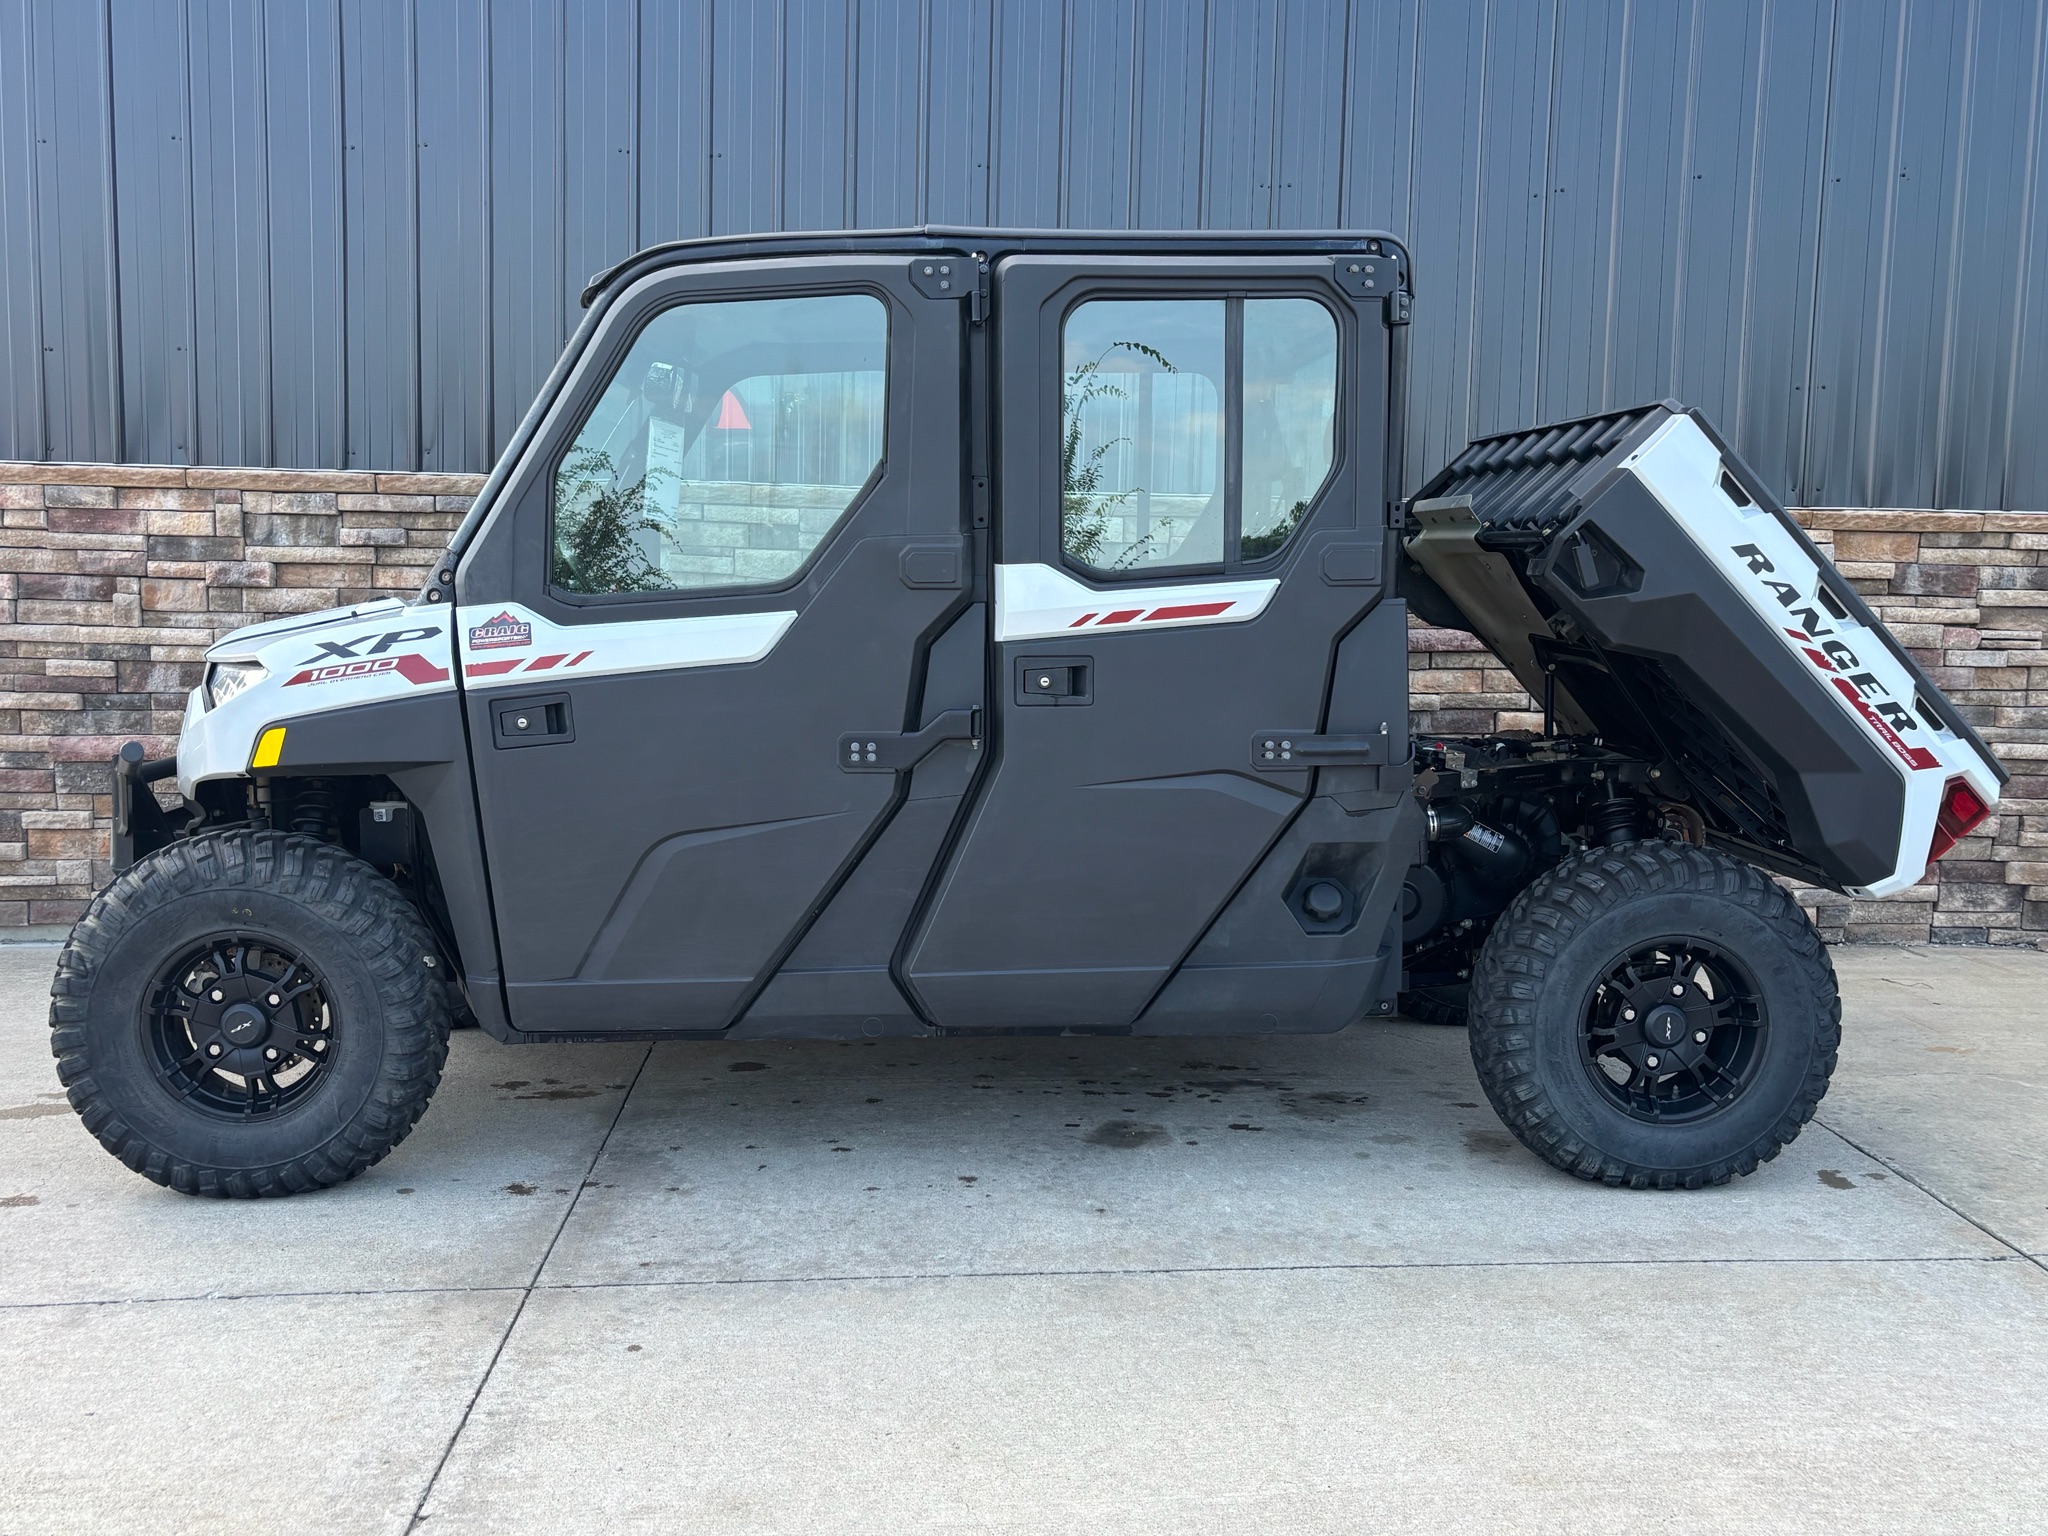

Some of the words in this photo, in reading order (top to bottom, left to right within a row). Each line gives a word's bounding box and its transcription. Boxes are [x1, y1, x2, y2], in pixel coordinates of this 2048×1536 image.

[294, 626, 443, 667] XP
[470, 624, 529, 638] CRAIG
[1731, 543, 1918, 733] RANGER
[310, 657, 400, 681] 1000
[329, 673, 372, 683] OVERHEAD
[1868, 715, 1892, 741] TRAIL
[1892, 741, 1918, 767] BOSS
